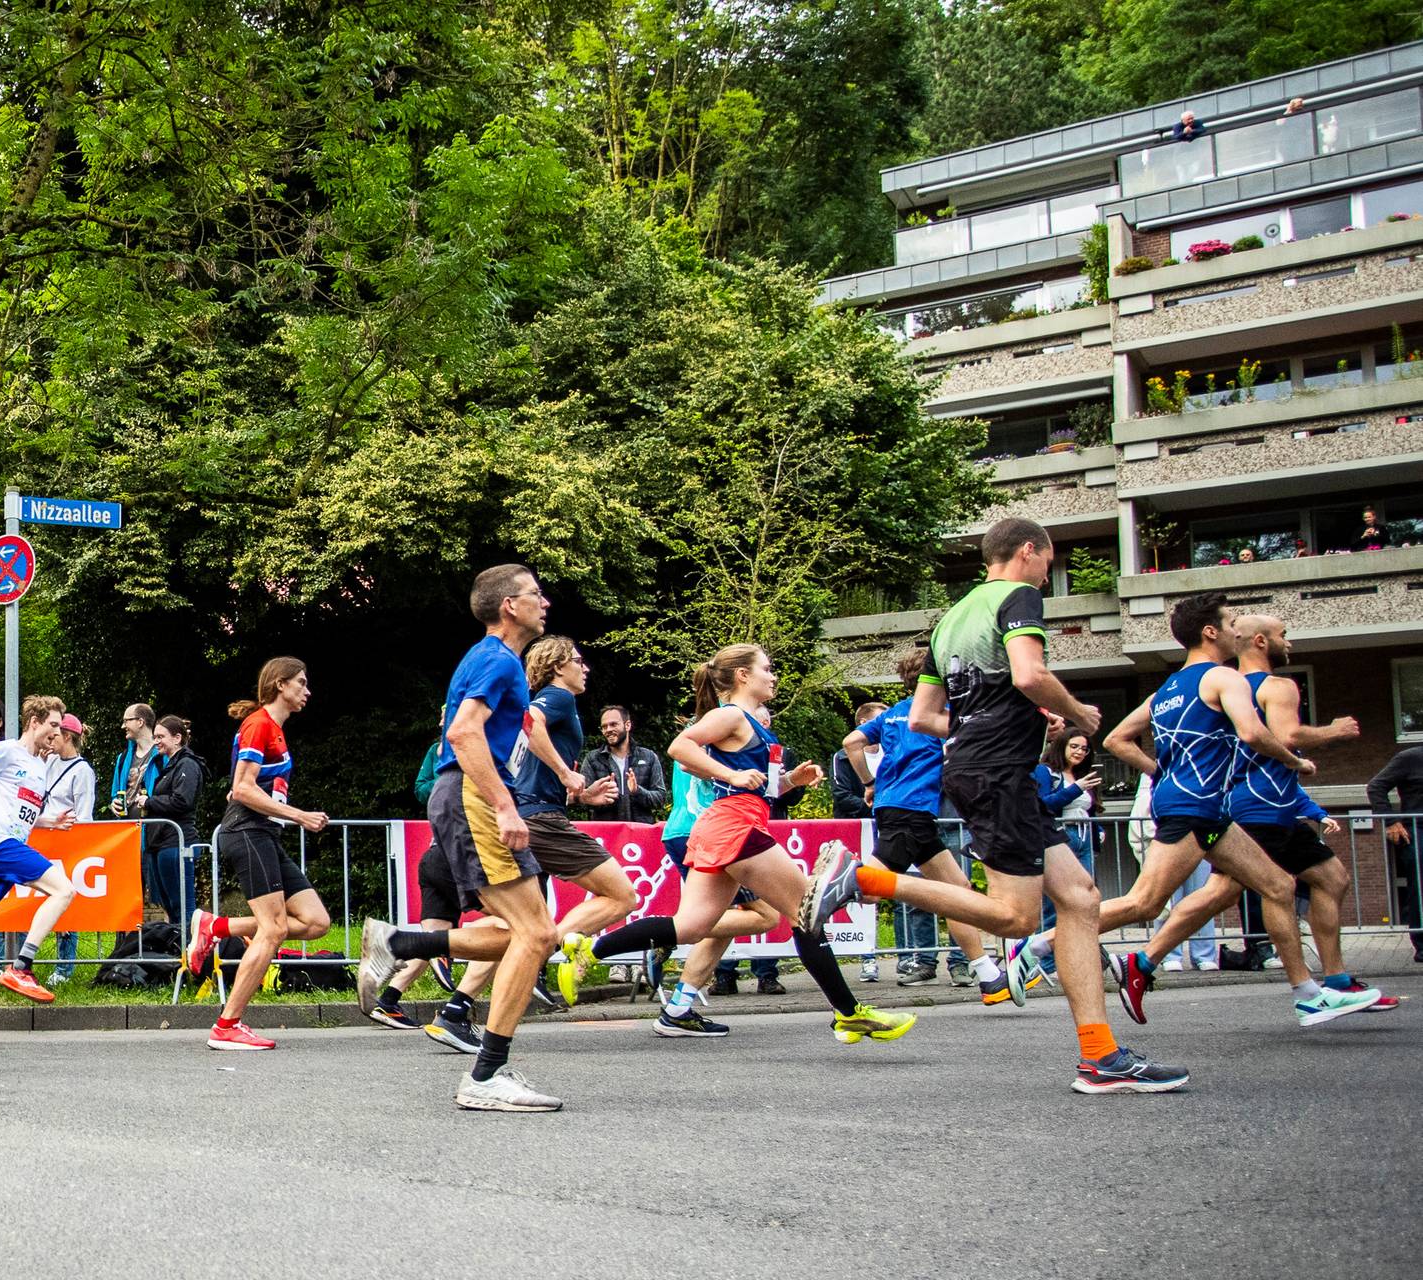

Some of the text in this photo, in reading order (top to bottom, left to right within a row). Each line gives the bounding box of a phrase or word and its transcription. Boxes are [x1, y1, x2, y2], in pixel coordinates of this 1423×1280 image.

[31, 500, 111, 524] Nizzaallee
[1154, 695, 1184, 713] AACHEN
[19, 805, 37, 825] 529
[834, 931, 864, 942] ASEAG
